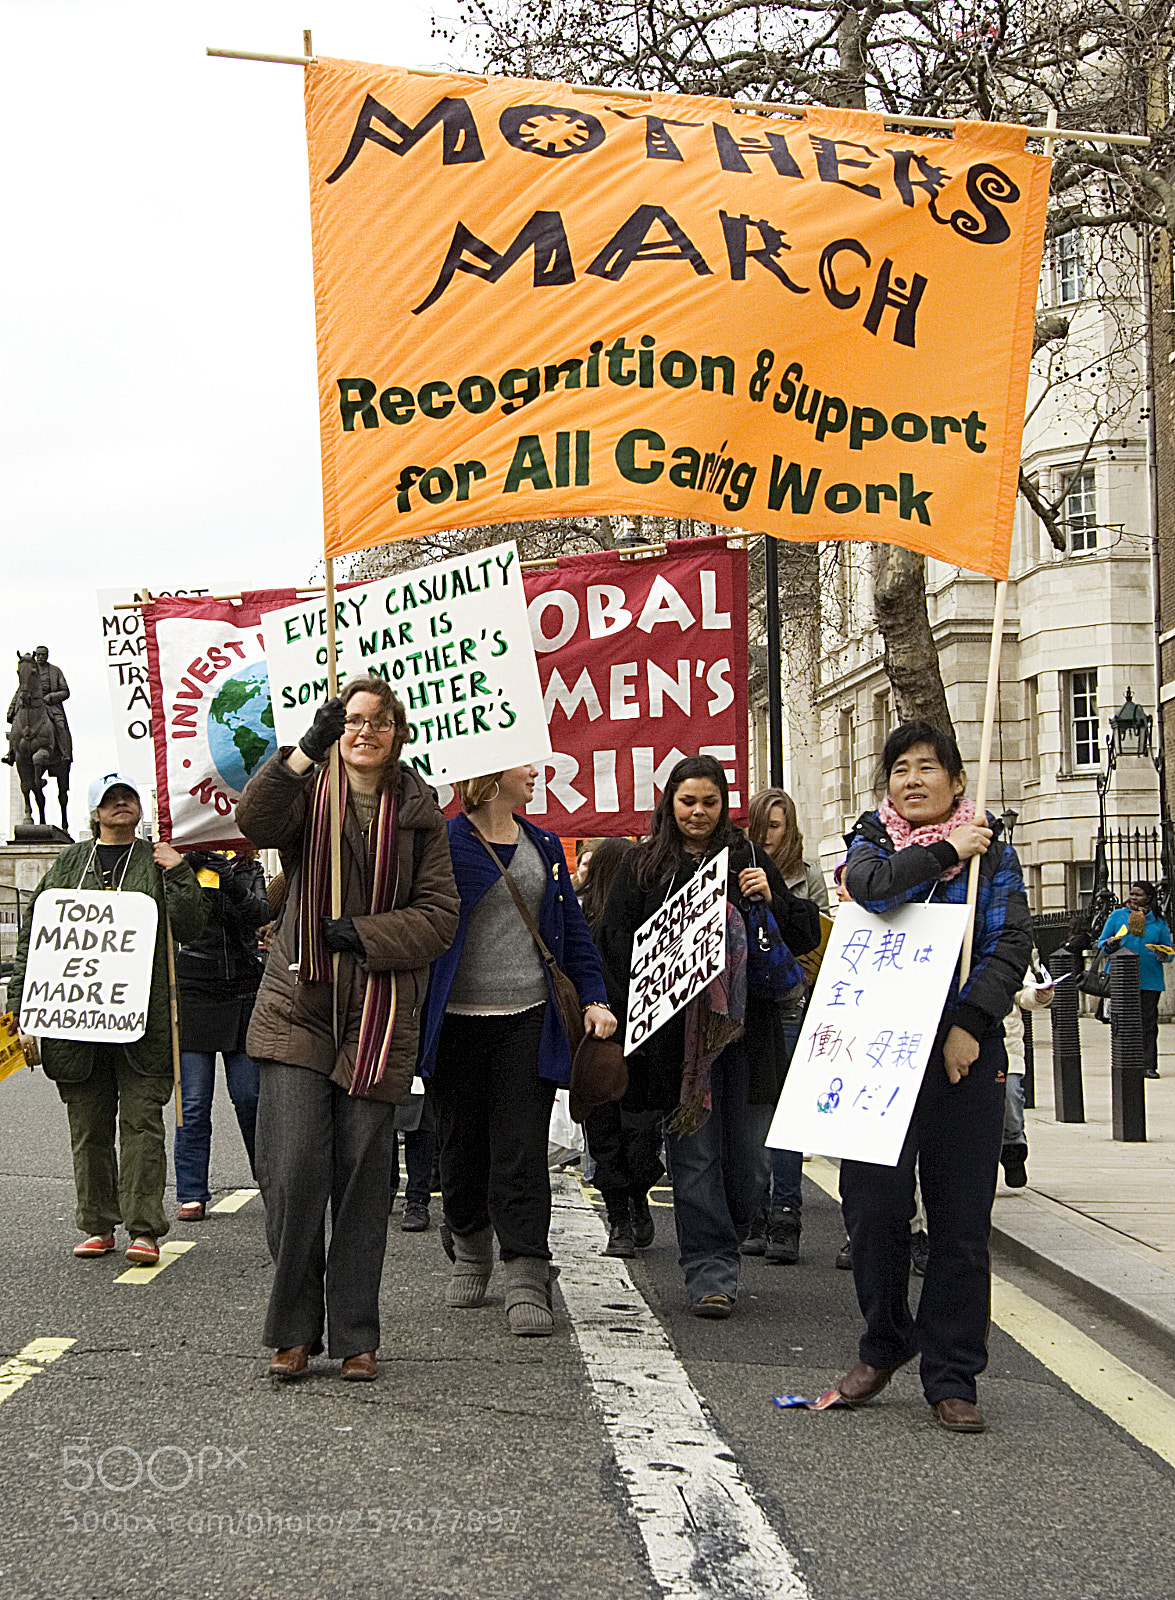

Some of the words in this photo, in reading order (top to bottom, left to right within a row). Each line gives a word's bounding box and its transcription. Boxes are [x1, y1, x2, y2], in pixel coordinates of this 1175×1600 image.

[325, 93, 1020, 245] MOTHERS
[411, 204, 928, 347] MARCH
[337, 335, 735, 431] Recognition
[748, 349, 777, 402] &
[773, 363, 988, 454] Support
[396, 460, 486, 514] for
[503, 429, 591, 493] All
[613, 427, 757, 512] Caring
[766, 454, 932, 526] Work
[284, 593, 368, 644] EVERY
[385, 551, 514, 615] CASUALTY
[527, 570, 731, 653] OBAL
[315, 640, 343, 666] OF
[359, 621, 412, 657] WAR
[430, 611, 453, 637] IS
[367, 628, 509, 683] MOTHER'S
[172, 641, 246, 739] INVEST
[408, 701, 517, 745] OTHER'S
[544, 658, 735, 725] MEN'S
[55, 899, 114, 924] TODA
[630, 879, 726, 980] CHILDREN
[636, 861, 718, 947] WOMEN
[657, 902, 694, 942] AND
[693, 911, 720, 946] OF
[35, 926, 137, 953] MADRE
[62, 957, 100, 978] ES
[628, 923, 724, 1023] CASUALTIES
[841, 929, 933, 974] 母親は
[26, 981, 129, 1005] MADRE
[630, 1004, 660, 1044] OF
[668, 950, 720, 1011] WAR
[826, 980, 864, 1006] 全て
